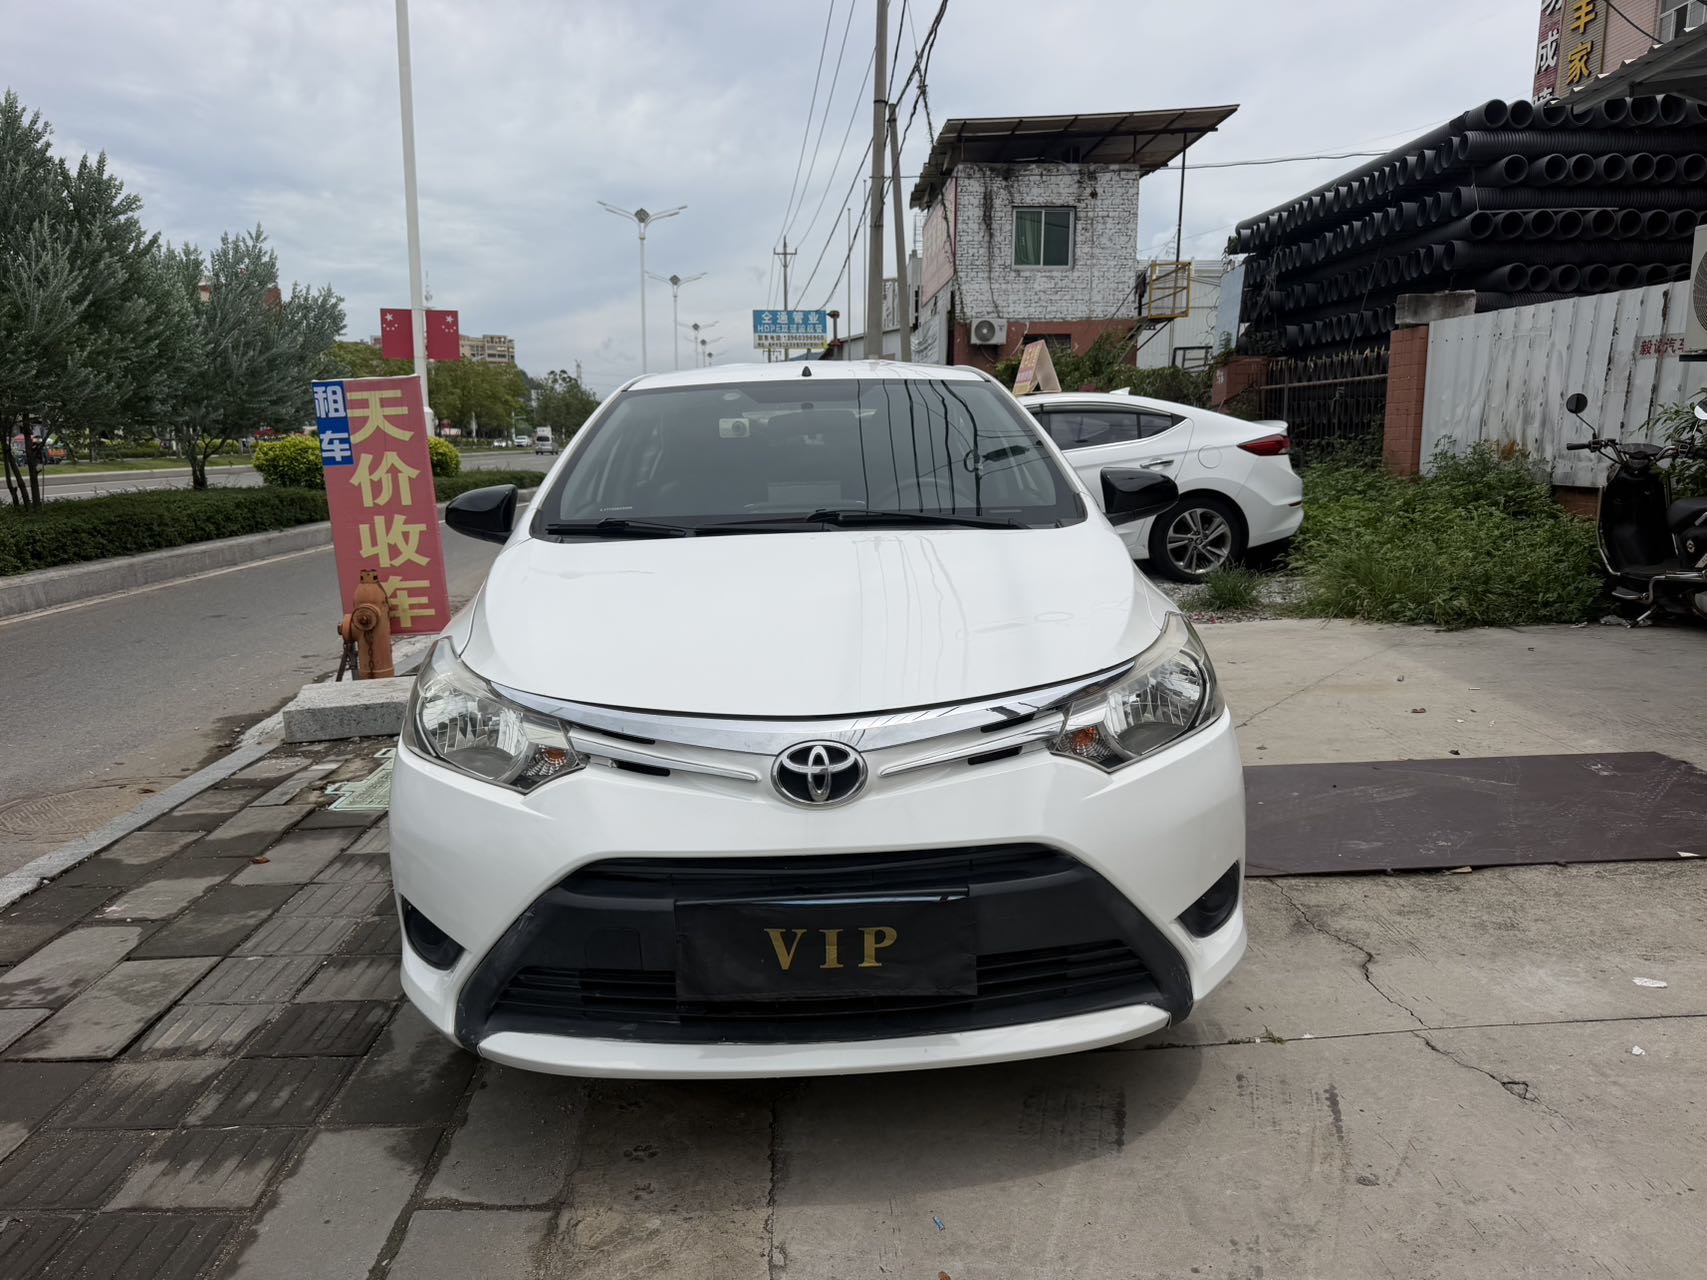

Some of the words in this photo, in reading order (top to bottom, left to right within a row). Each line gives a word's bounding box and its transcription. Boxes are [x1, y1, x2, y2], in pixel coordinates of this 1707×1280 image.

[313, 385, 351, 462] 租车
[346, 388, 436, 628] 天价收车
[764, 926, 898, 970] VIP
